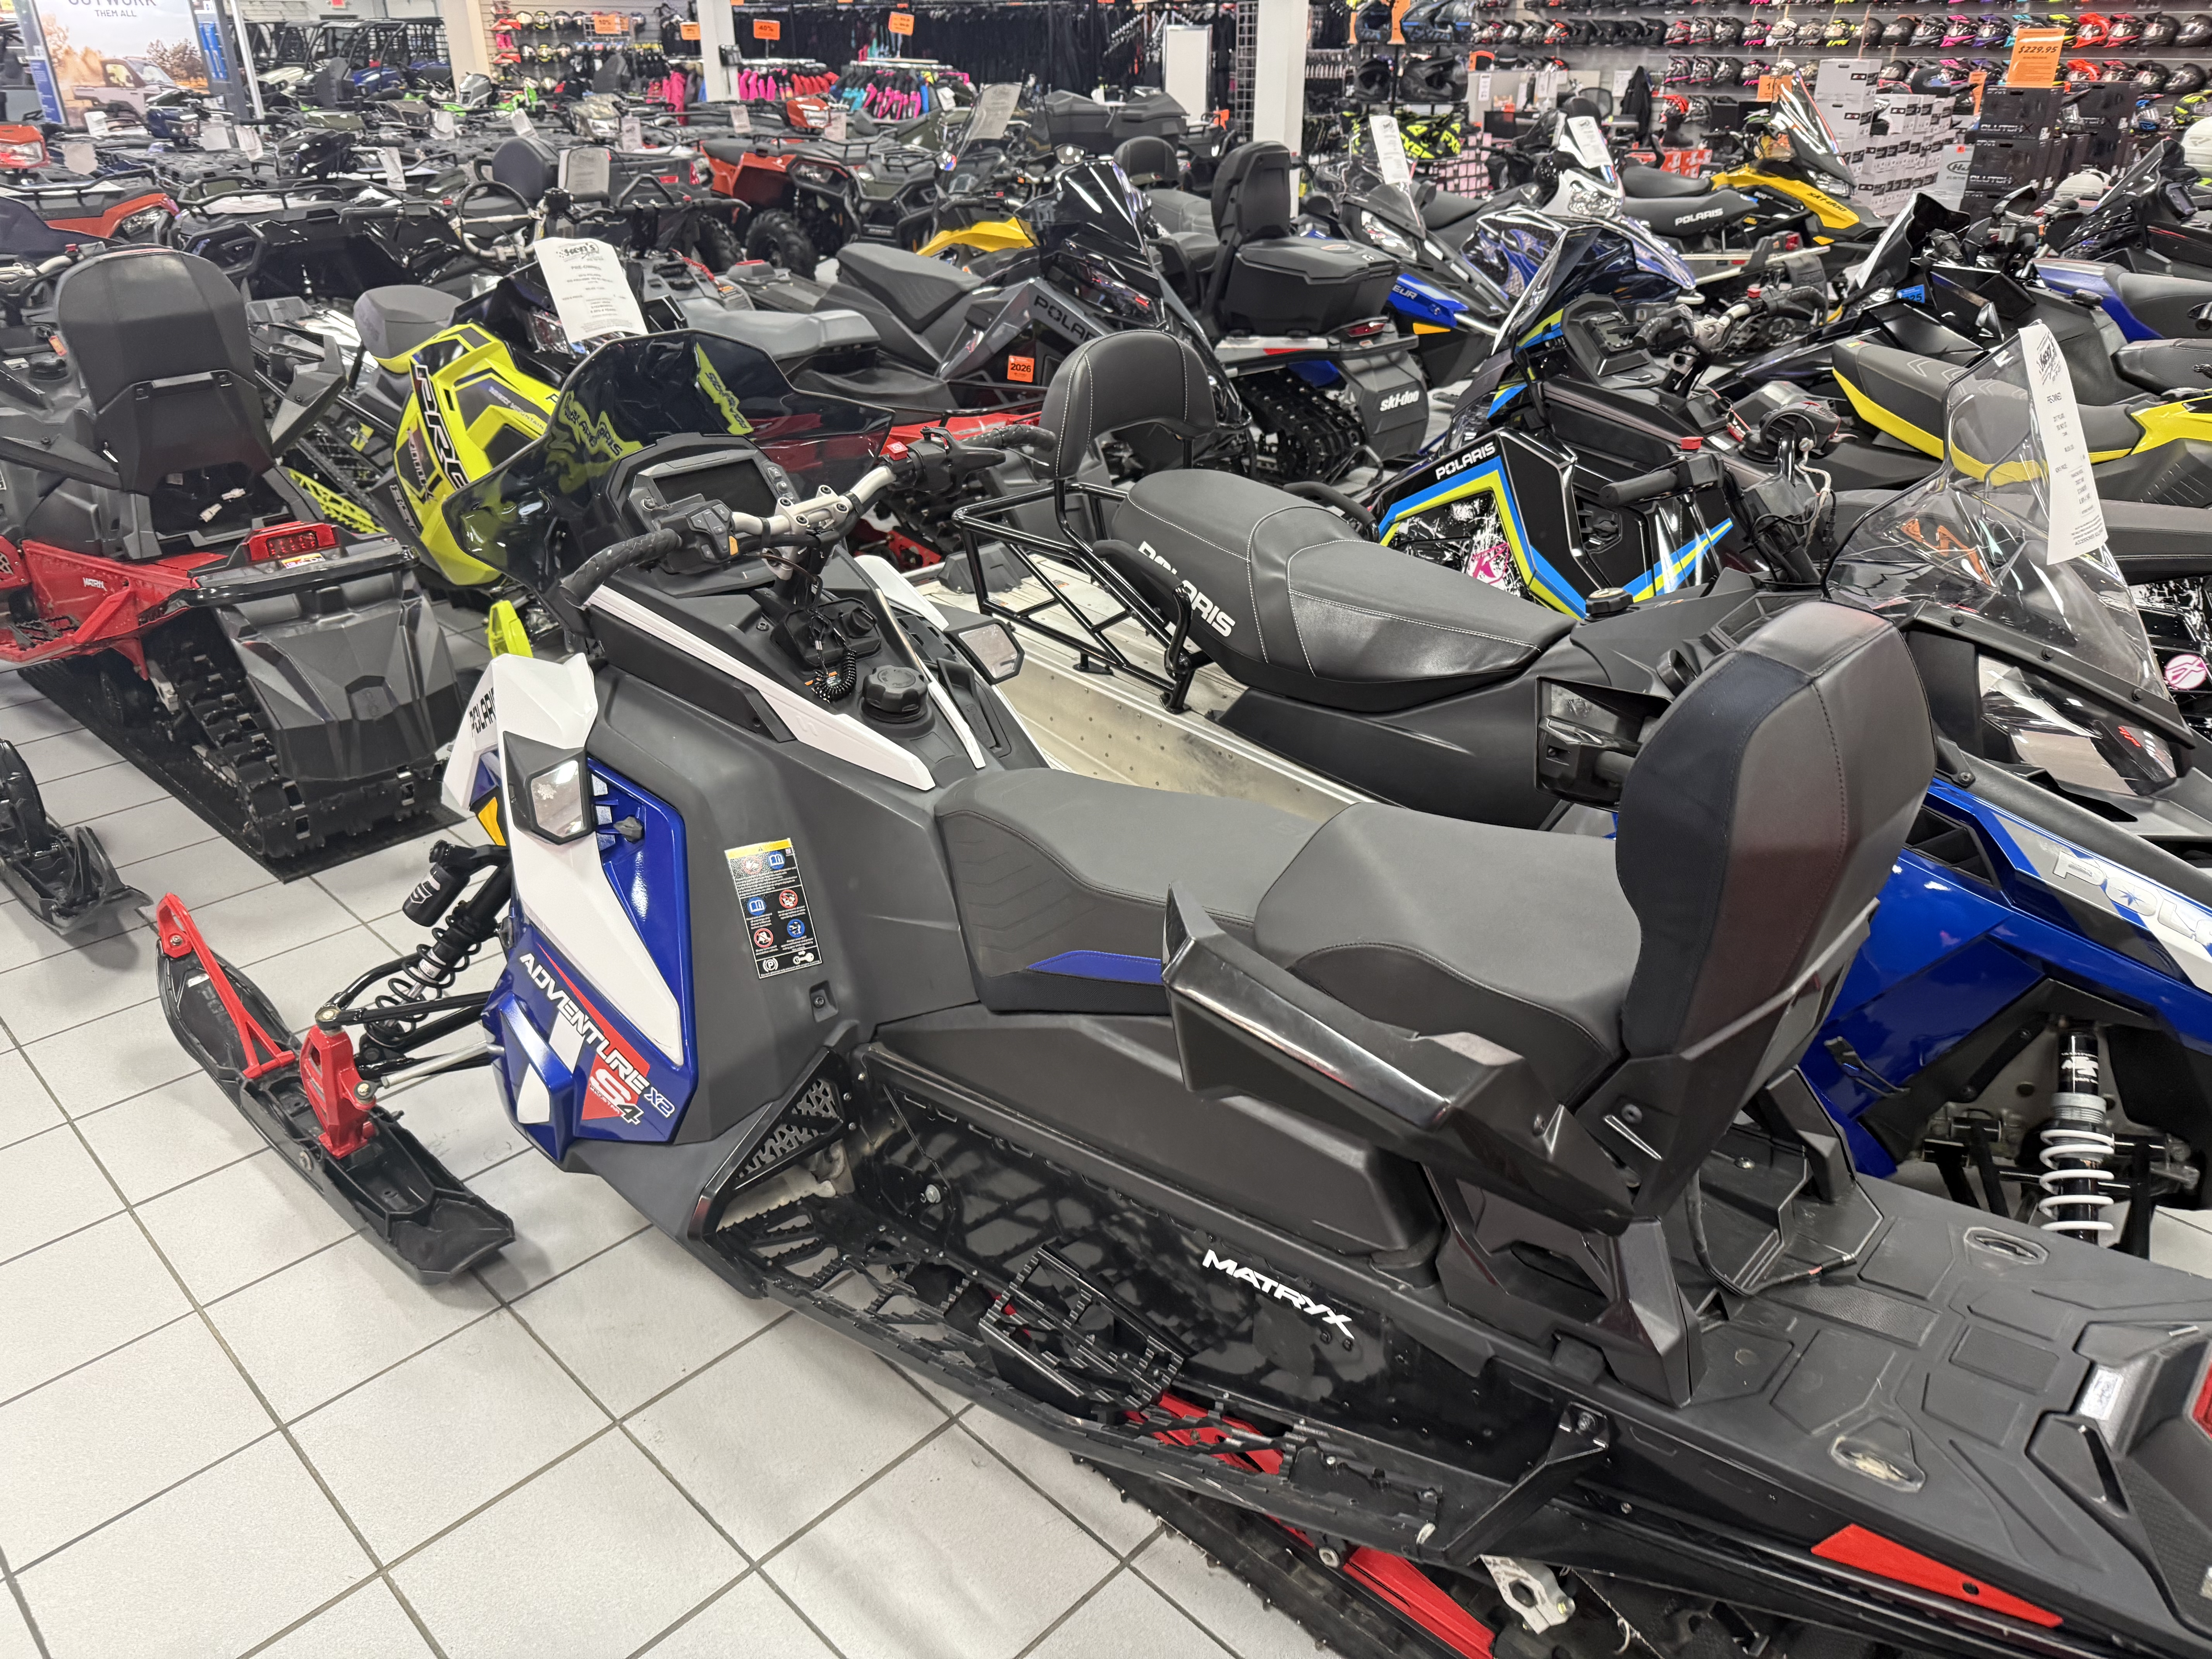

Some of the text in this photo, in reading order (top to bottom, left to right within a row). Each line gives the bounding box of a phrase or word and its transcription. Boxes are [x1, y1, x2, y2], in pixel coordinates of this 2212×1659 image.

[1675, 208, 1723, 226] POLARIS
[1392, 285, 1418, 300] EUR
[1010, 363, 1031, 373] 2026
[1380, 390, 1419, 412] ski-doo
[1435, 441, 1496, 480] POLARIS
[1138, 541, 1236, 637] PARIS
[519, 953, 650, 1095] ADVENTURE
[643, 1087, 675, 1118] X2
[1202, 1249, 1355, 1340] MATRYX
